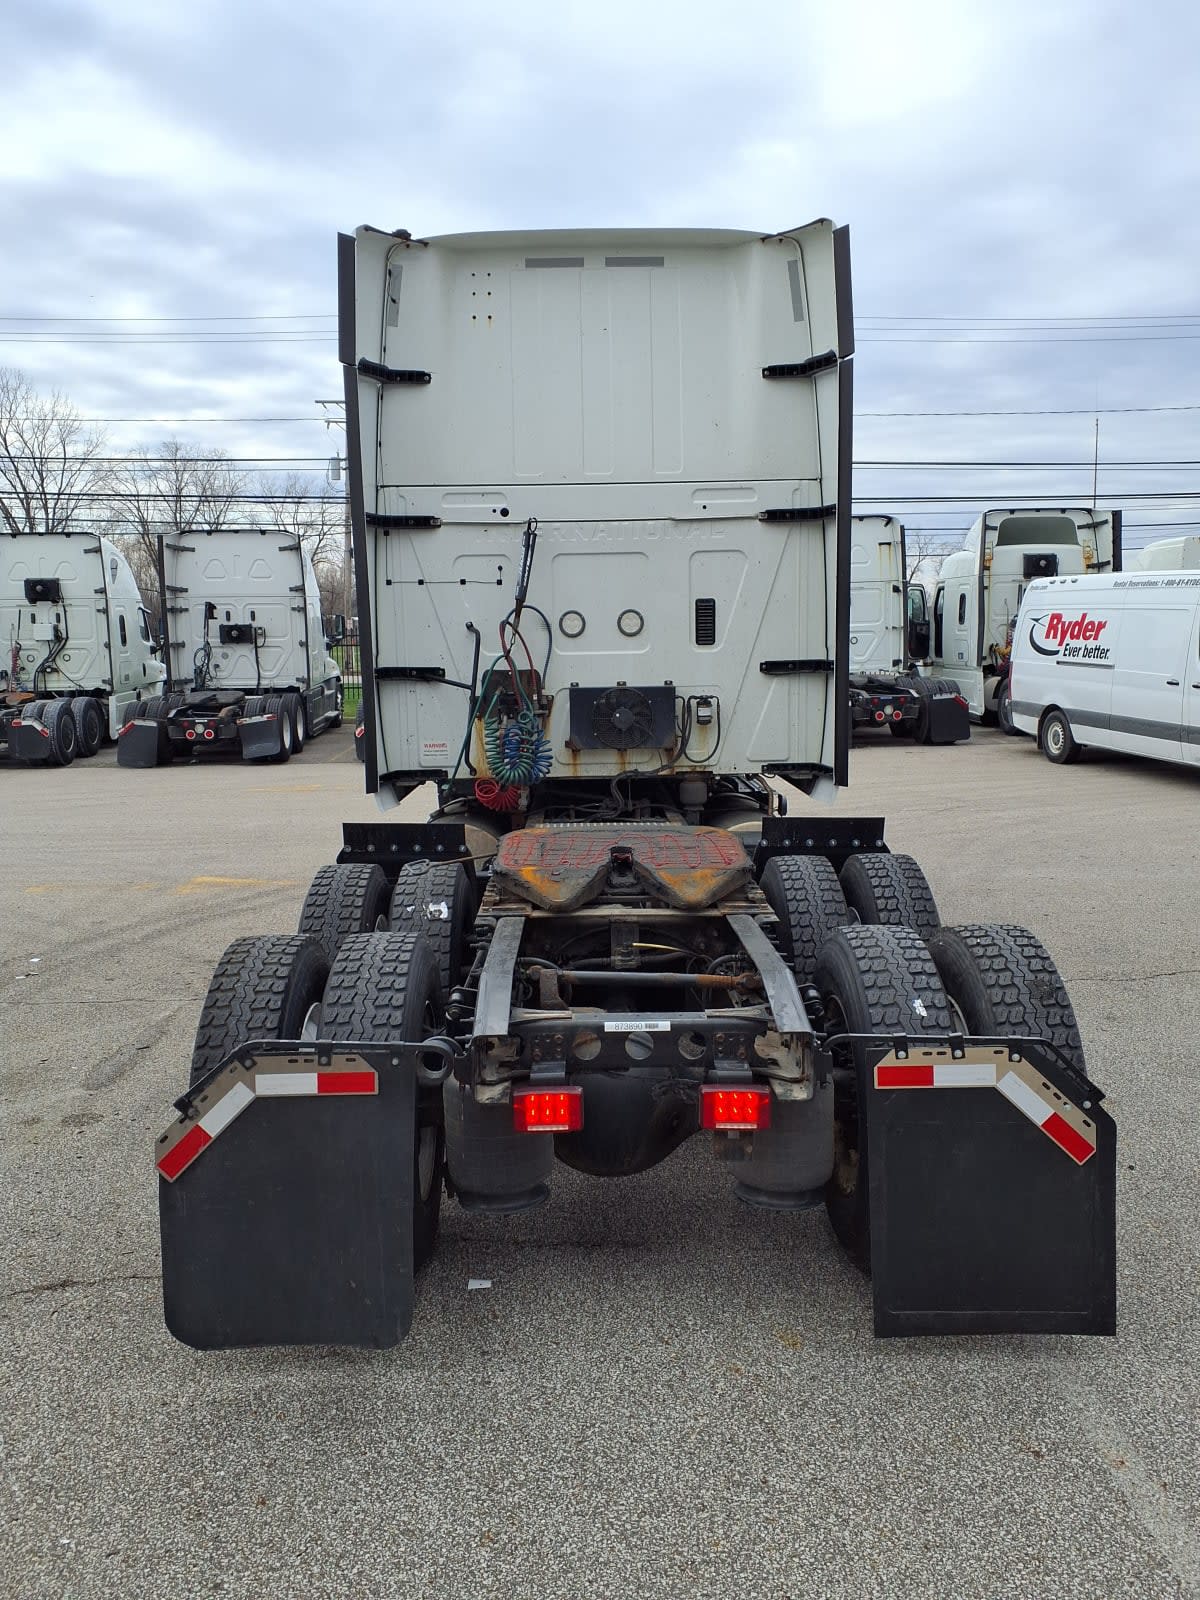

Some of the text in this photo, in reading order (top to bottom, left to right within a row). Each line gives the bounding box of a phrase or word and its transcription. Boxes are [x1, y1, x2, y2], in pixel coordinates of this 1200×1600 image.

[1044, 612, 1108, 647] Ryder
[1062, 643, 1111, 660] Ever better.
[614, 1022, 643, 1031] 873890
